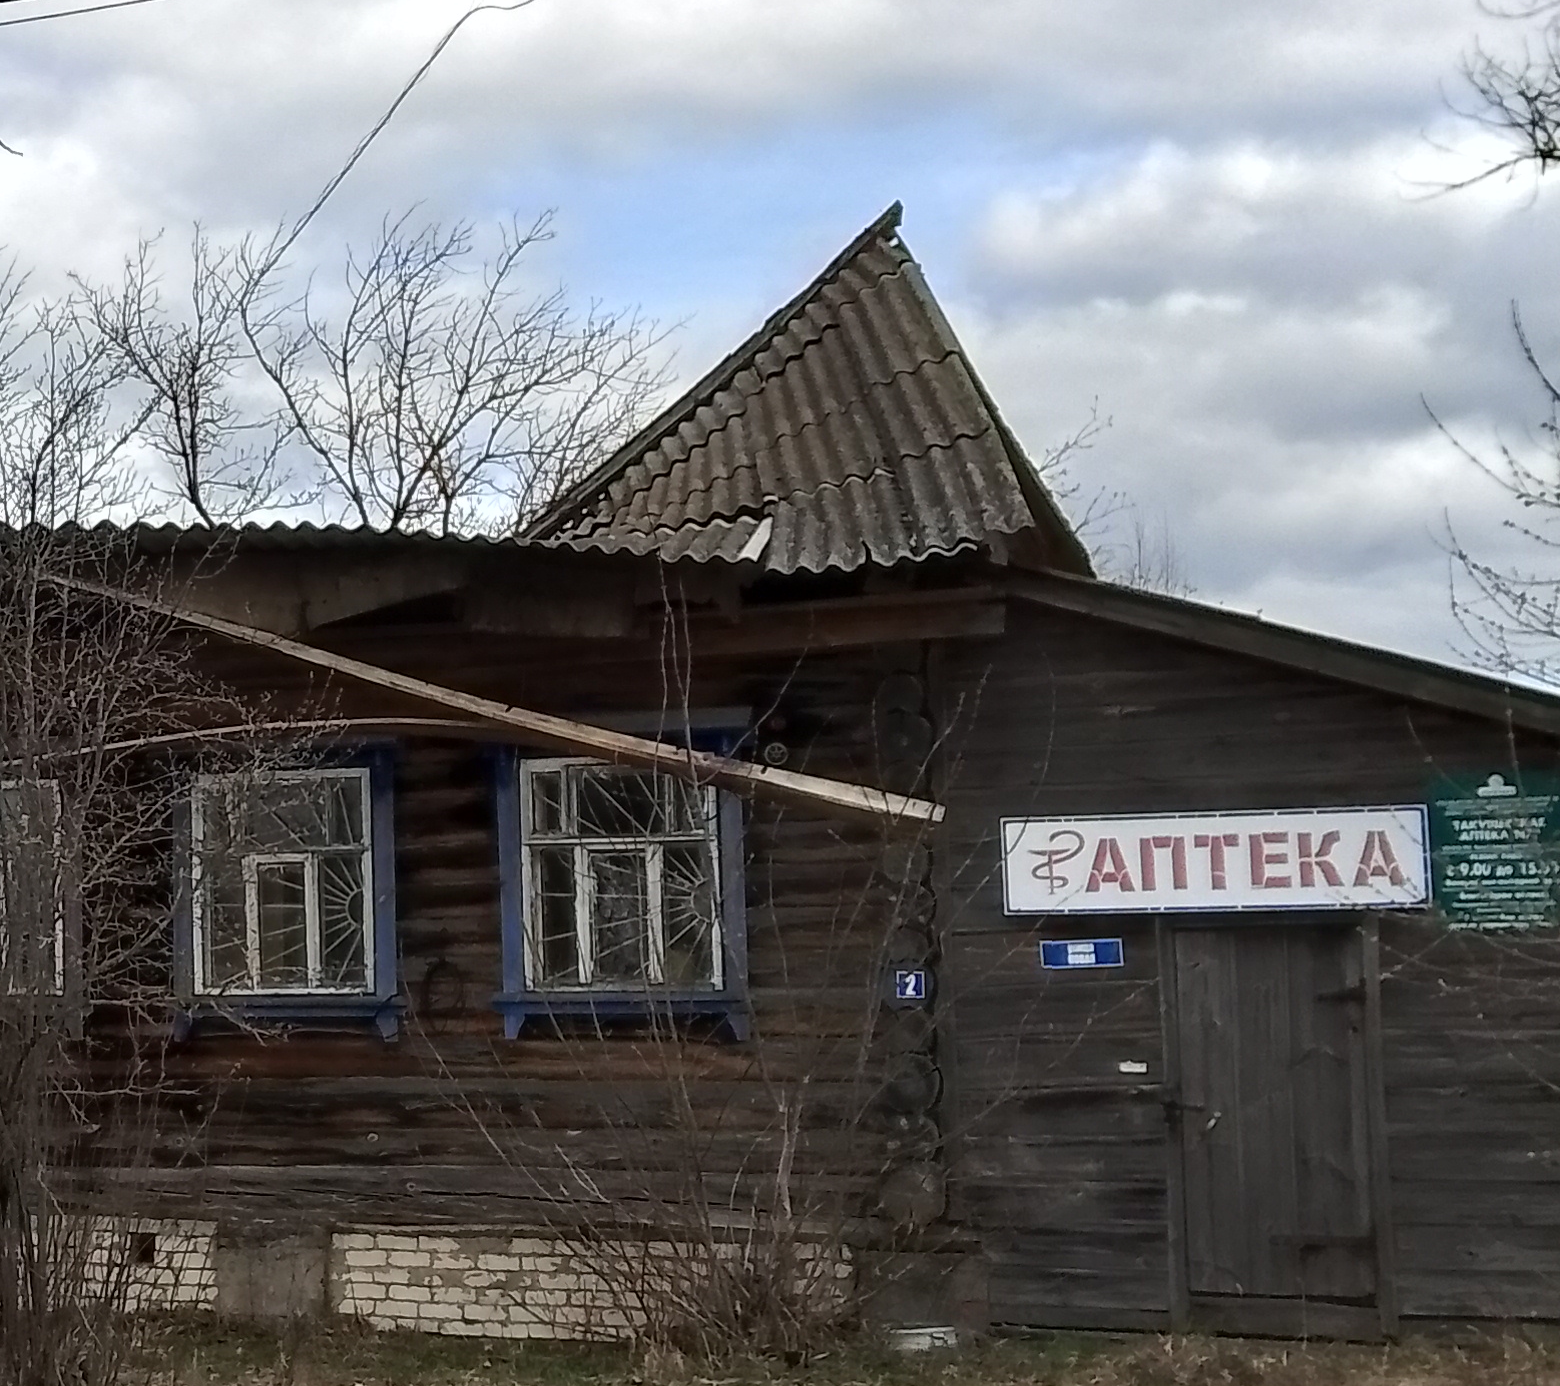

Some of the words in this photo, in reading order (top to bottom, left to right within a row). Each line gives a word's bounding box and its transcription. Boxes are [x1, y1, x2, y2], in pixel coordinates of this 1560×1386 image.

[1084, 829, 1405, 893] АПТЕКА
[1495, 864, 1514, 877] до
[905, 974, 916, 996] 2
